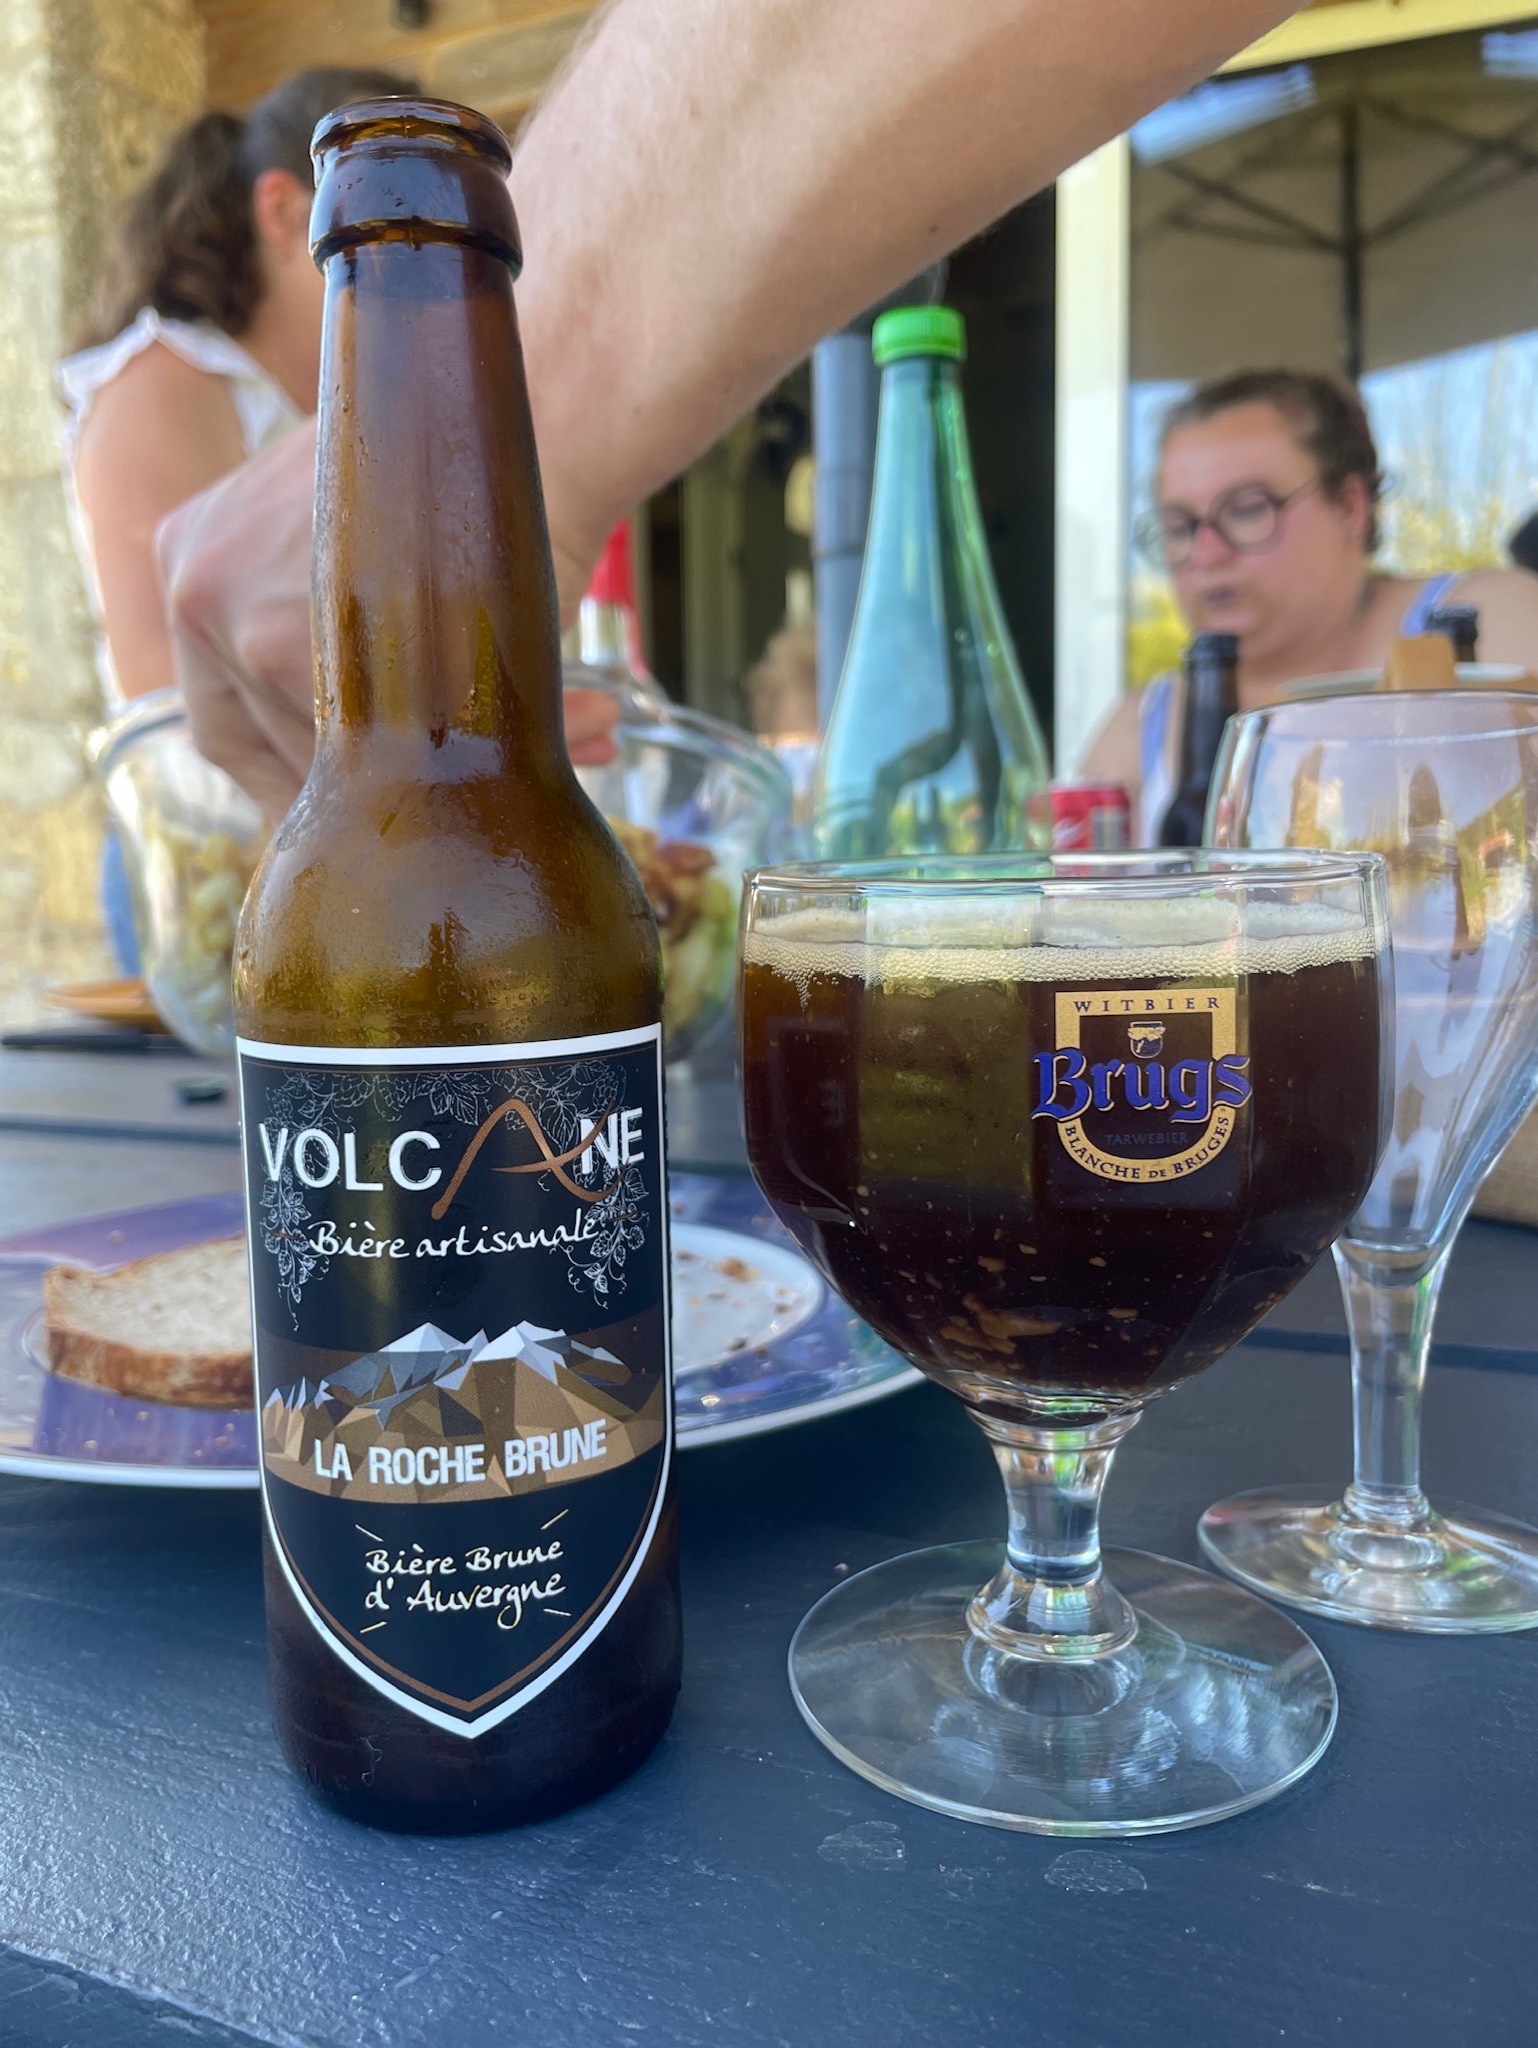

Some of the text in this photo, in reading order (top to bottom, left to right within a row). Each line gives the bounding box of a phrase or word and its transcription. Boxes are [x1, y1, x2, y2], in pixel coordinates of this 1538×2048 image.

[1074, 997, 1220, 1013] WITBIER
[1031, 1048, 1252, 1123] Brugs
[259, 1098, 646, 1221] VOLCANE
[1064, 1124, 1141, 1179] BLANCHE
[1173, 1116, 1230, 1174] BRUGES
[1105, 1131, 1188, 1146] TARWEBIER
[308, 1207, 600, 1259] Bière artisanale
[314, 1418, 607, 1486] LA ROCHE BRUNE
[365, 1539, 564, 1575] Bière Brune
[406, 1571, 567, 1630] Auvergne
